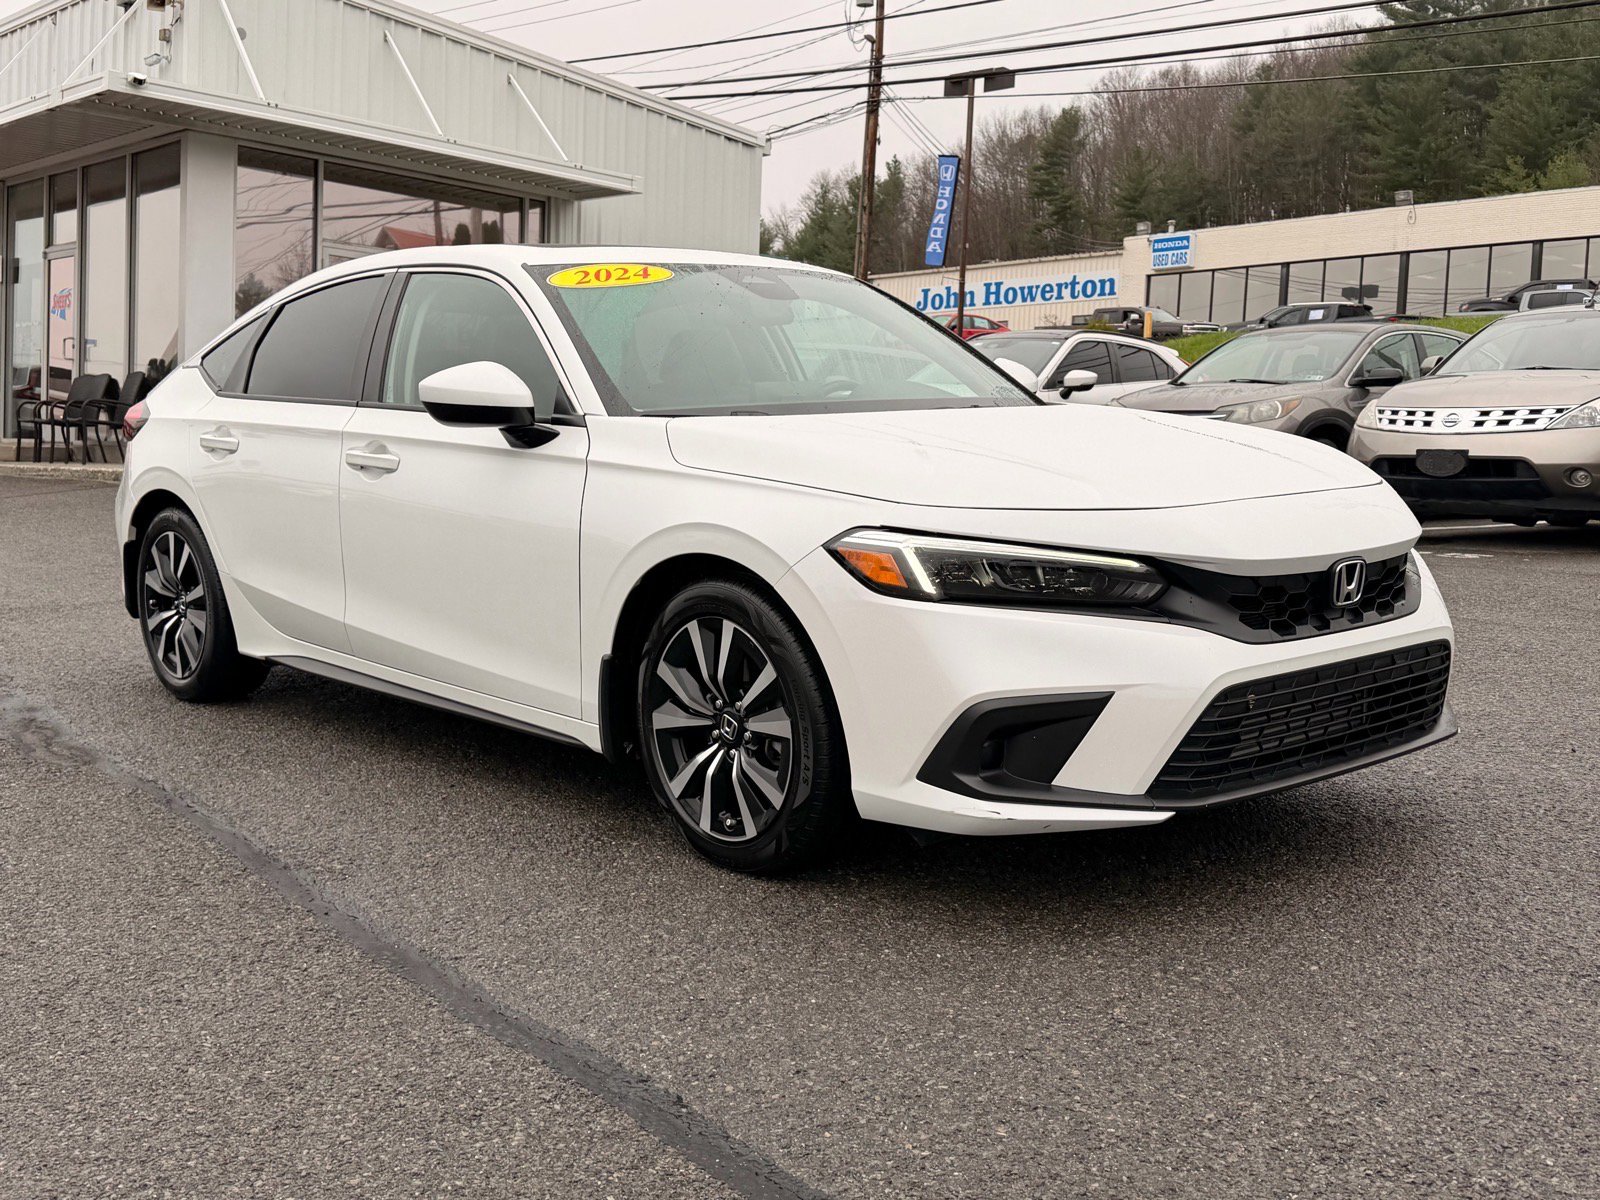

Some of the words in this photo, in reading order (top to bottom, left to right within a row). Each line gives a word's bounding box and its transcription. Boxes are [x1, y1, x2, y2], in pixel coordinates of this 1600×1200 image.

[1153, 240, 1189, 249] HONDA
[1153, 253, 1169, 267] USED
[1171, 252, 1187, 265] CARS
[574, 266, 651, 285] 2024
[916, 286, 976, 311] John
[982, 275, 1117, 306] Howerton
[800, 725, 810, 760] Sport
